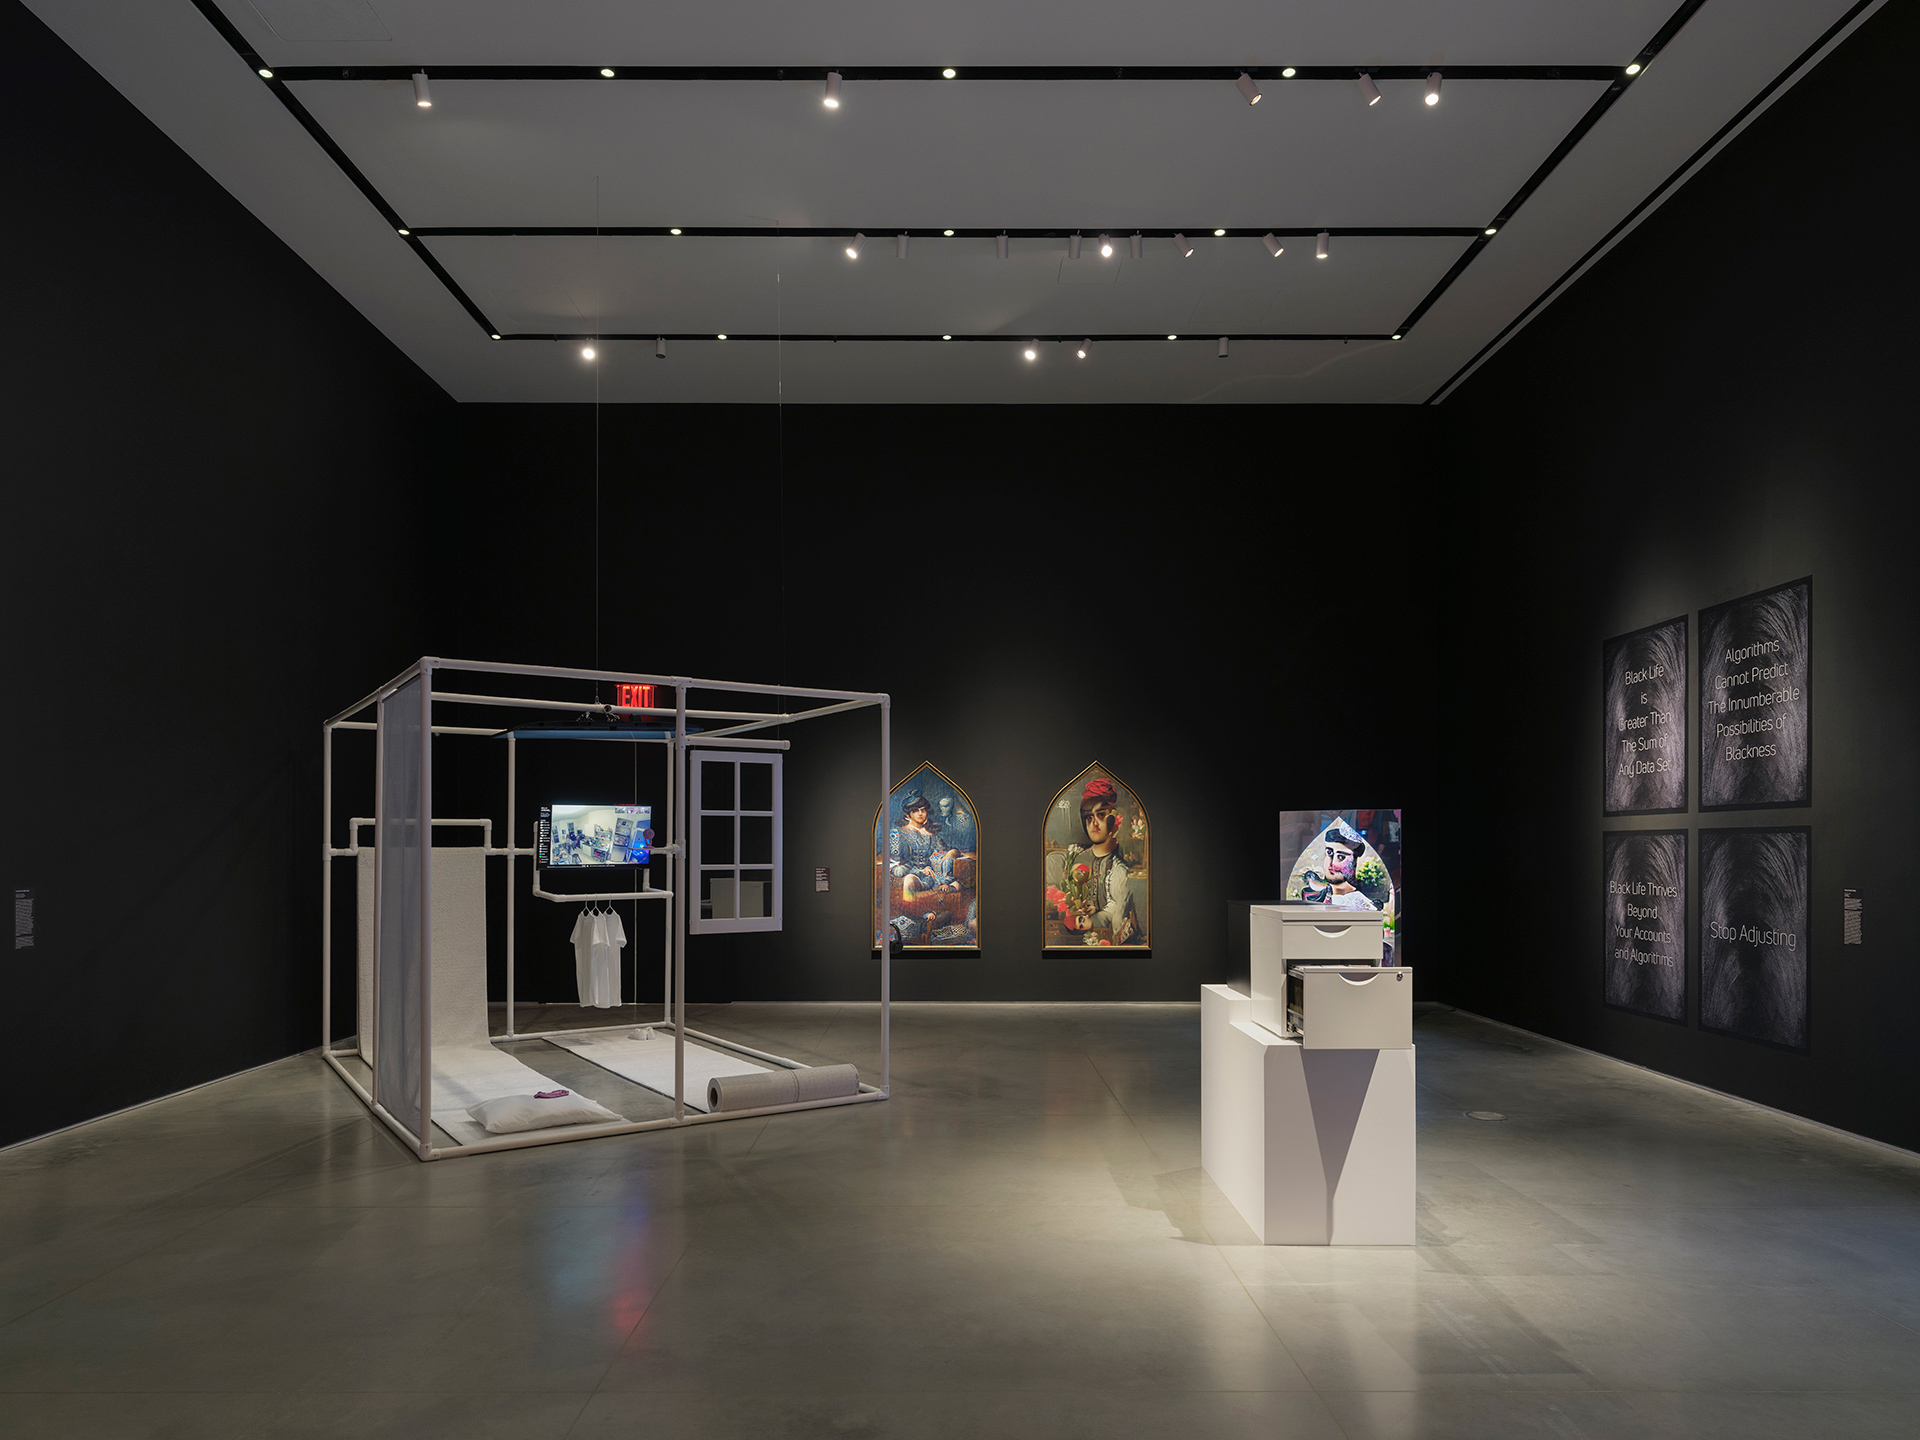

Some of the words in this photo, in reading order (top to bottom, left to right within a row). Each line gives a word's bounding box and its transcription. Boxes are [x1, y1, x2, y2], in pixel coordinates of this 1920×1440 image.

[1725, 638, 1780, 665] Algorithms
[1625, 668, 1647, 685] Black
[1649, 664, 1664, 680] Life
[1714, 670, 1749, 690] Cannot
[1751, 662, 1788, 681] Predict
[622, 684, 651, 708] EXIT
[1640, 691, 1648, 704] is
[1708, 700, 1727, 714] The
[1728, 687, 1800, 711] Innumberable
[1618, 715, 1648, 731] Greater
[1650, 711, 1671, 725] Than
[1716, 718, 1773, 737] Possibilities
[1775, 712, 1787, 729] of
[1622, 739, 1637, 753] The
[1638, 737, 1657, 751] Sum
[1659, 733, 1669, 748] of
[1725, 744, 1777, 761] Blackness
[1618, 764, 1635, 778] Any
[1636, 760, 1655, 774] Data
[1656, 757, 1671, 772] Set
[1610, 881, 1632, 895] Black
[1632, 881, 1646, 896] Life
[1647, 882, 1677, 898] Thrives
[1627, 904, 1658, 920] Beyond
[1615, 924, 1634, 939] Your
[1634, 928, 1671, 944] Accounts
[1710, 921, 1737, 942] Stop
[1739, 924, 1797, 951] Adjusting
[1614, 947, 1630, 960] and
[1630, 948, 1674, 967] Algorithms
